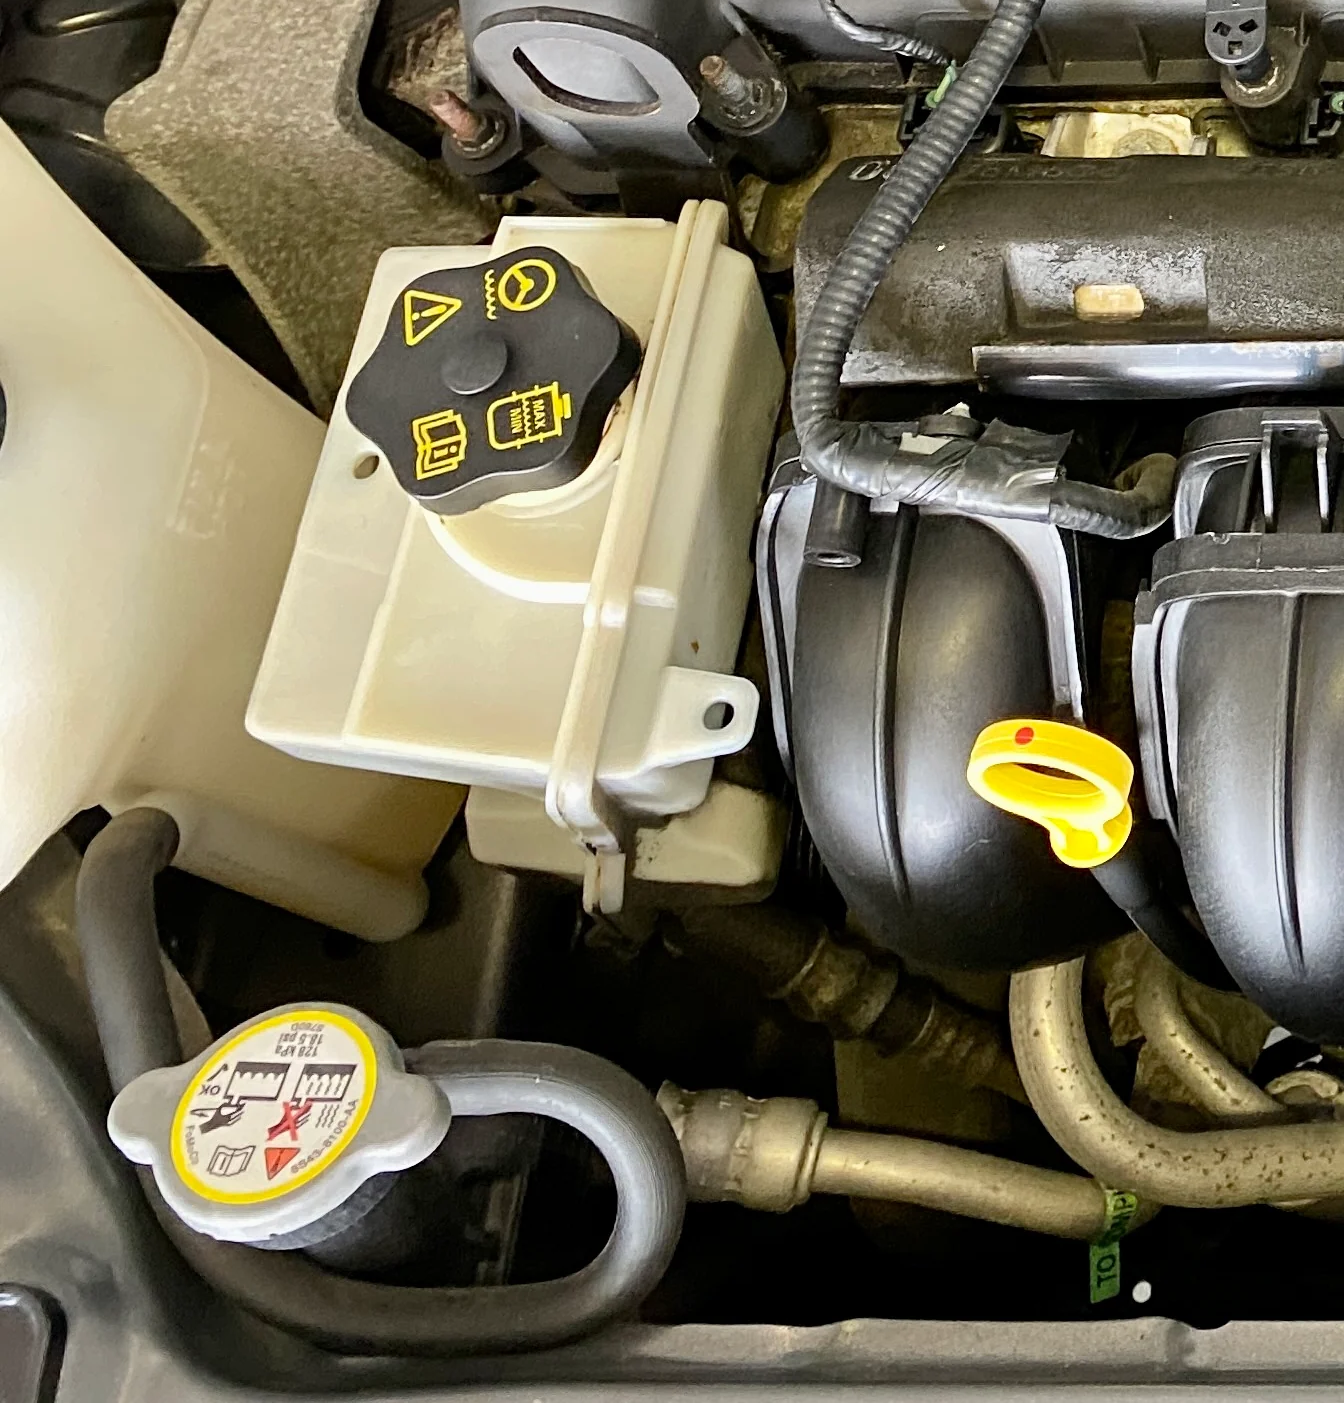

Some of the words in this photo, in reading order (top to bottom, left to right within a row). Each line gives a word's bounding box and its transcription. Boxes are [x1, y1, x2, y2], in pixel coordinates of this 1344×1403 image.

[531, 396, 548, 430] MAX
[508, 407, 524, 434] MIN
[277, 1033, 297, 1044] psi
[298, 1033, 324, 1045] 18.5
[275, 1045, 297, 1057] kPa
[296, 1045, 319, 1057] 128
[197, 1083, 221, 1096] OK
[1096, 1253, 1118, 1289] TO
